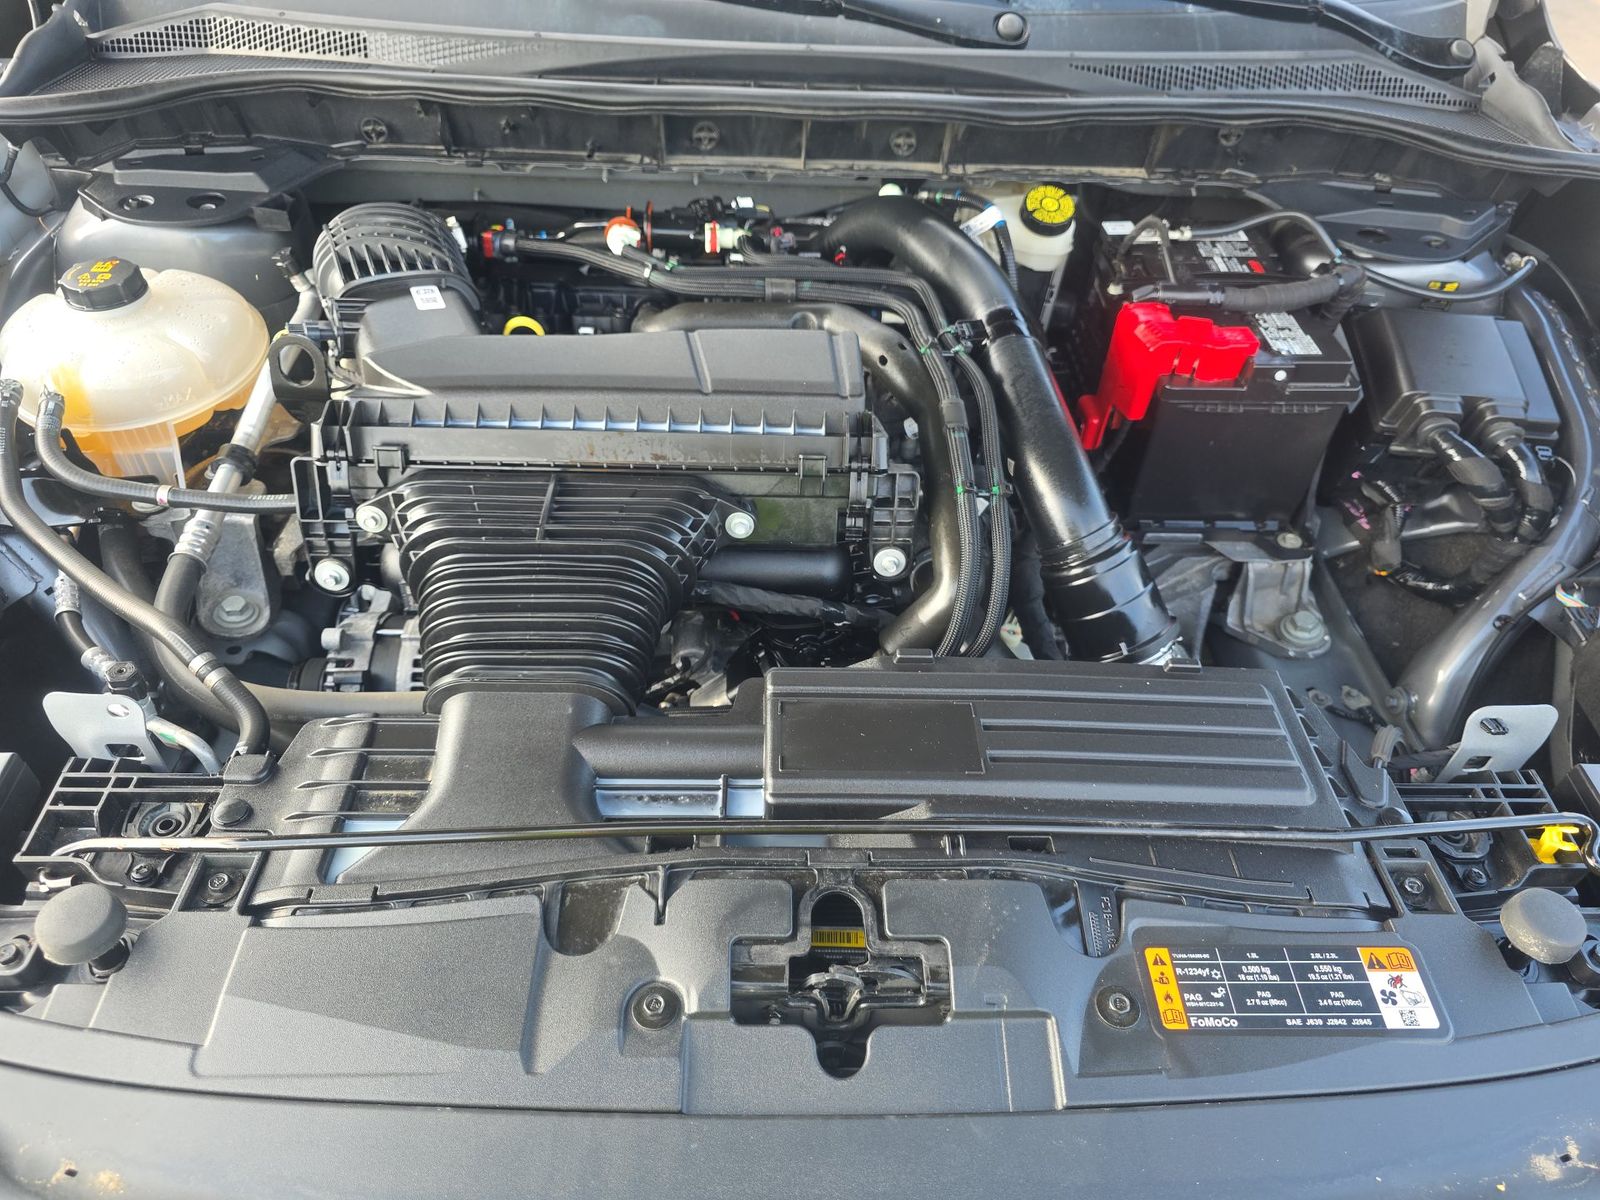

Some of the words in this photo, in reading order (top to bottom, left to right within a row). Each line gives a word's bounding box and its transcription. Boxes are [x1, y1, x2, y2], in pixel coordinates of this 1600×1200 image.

[1175, 967, 1210, 977] R-1234yf
[1241, 965, 1260, 973] 0.500
[1260, 965, 1271, 975] kg
[1313, 964, 1332, 973] 0.550
[1331, 965, 1343, 974] kg
[1183, 993, 1203, 1001] PAG
[1256, 990, 1272, 998] PAG
[1340, 999, 1363, 1008] (100cc)
[1189, 1016, 1239, 1027] FoMoCo
[1285, 1018, 1303, 1026] SAE
